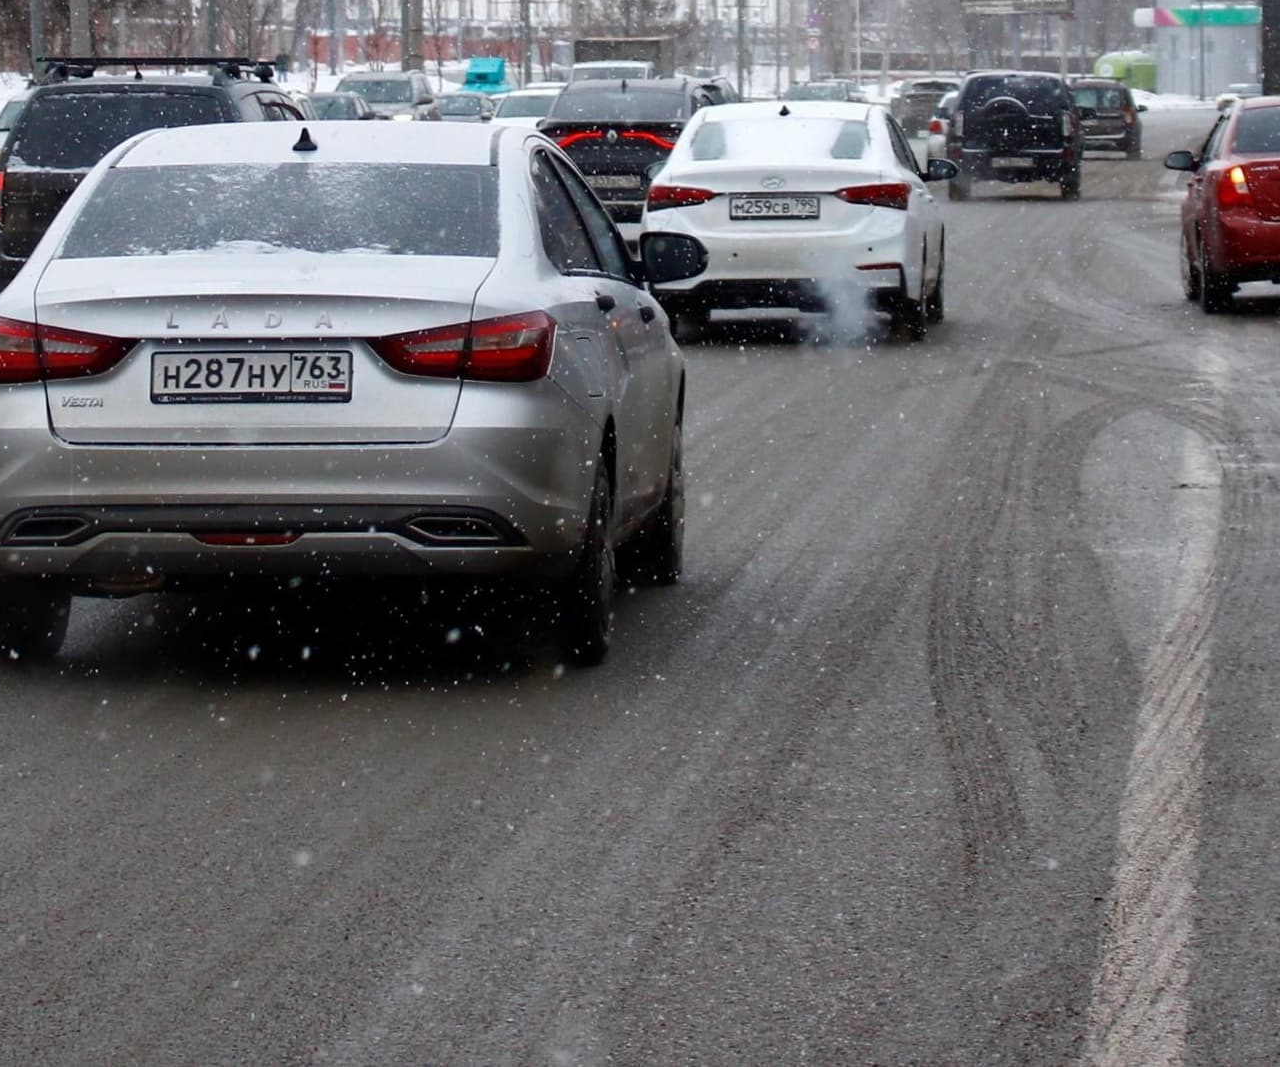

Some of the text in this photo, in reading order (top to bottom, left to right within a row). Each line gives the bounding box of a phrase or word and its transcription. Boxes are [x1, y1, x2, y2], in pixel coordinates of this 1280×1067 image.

[166, 308, 333, 329] LADA
[162, 356, 342, 389] Н287НУ 763
[304, 380, 327, 389] RUS
